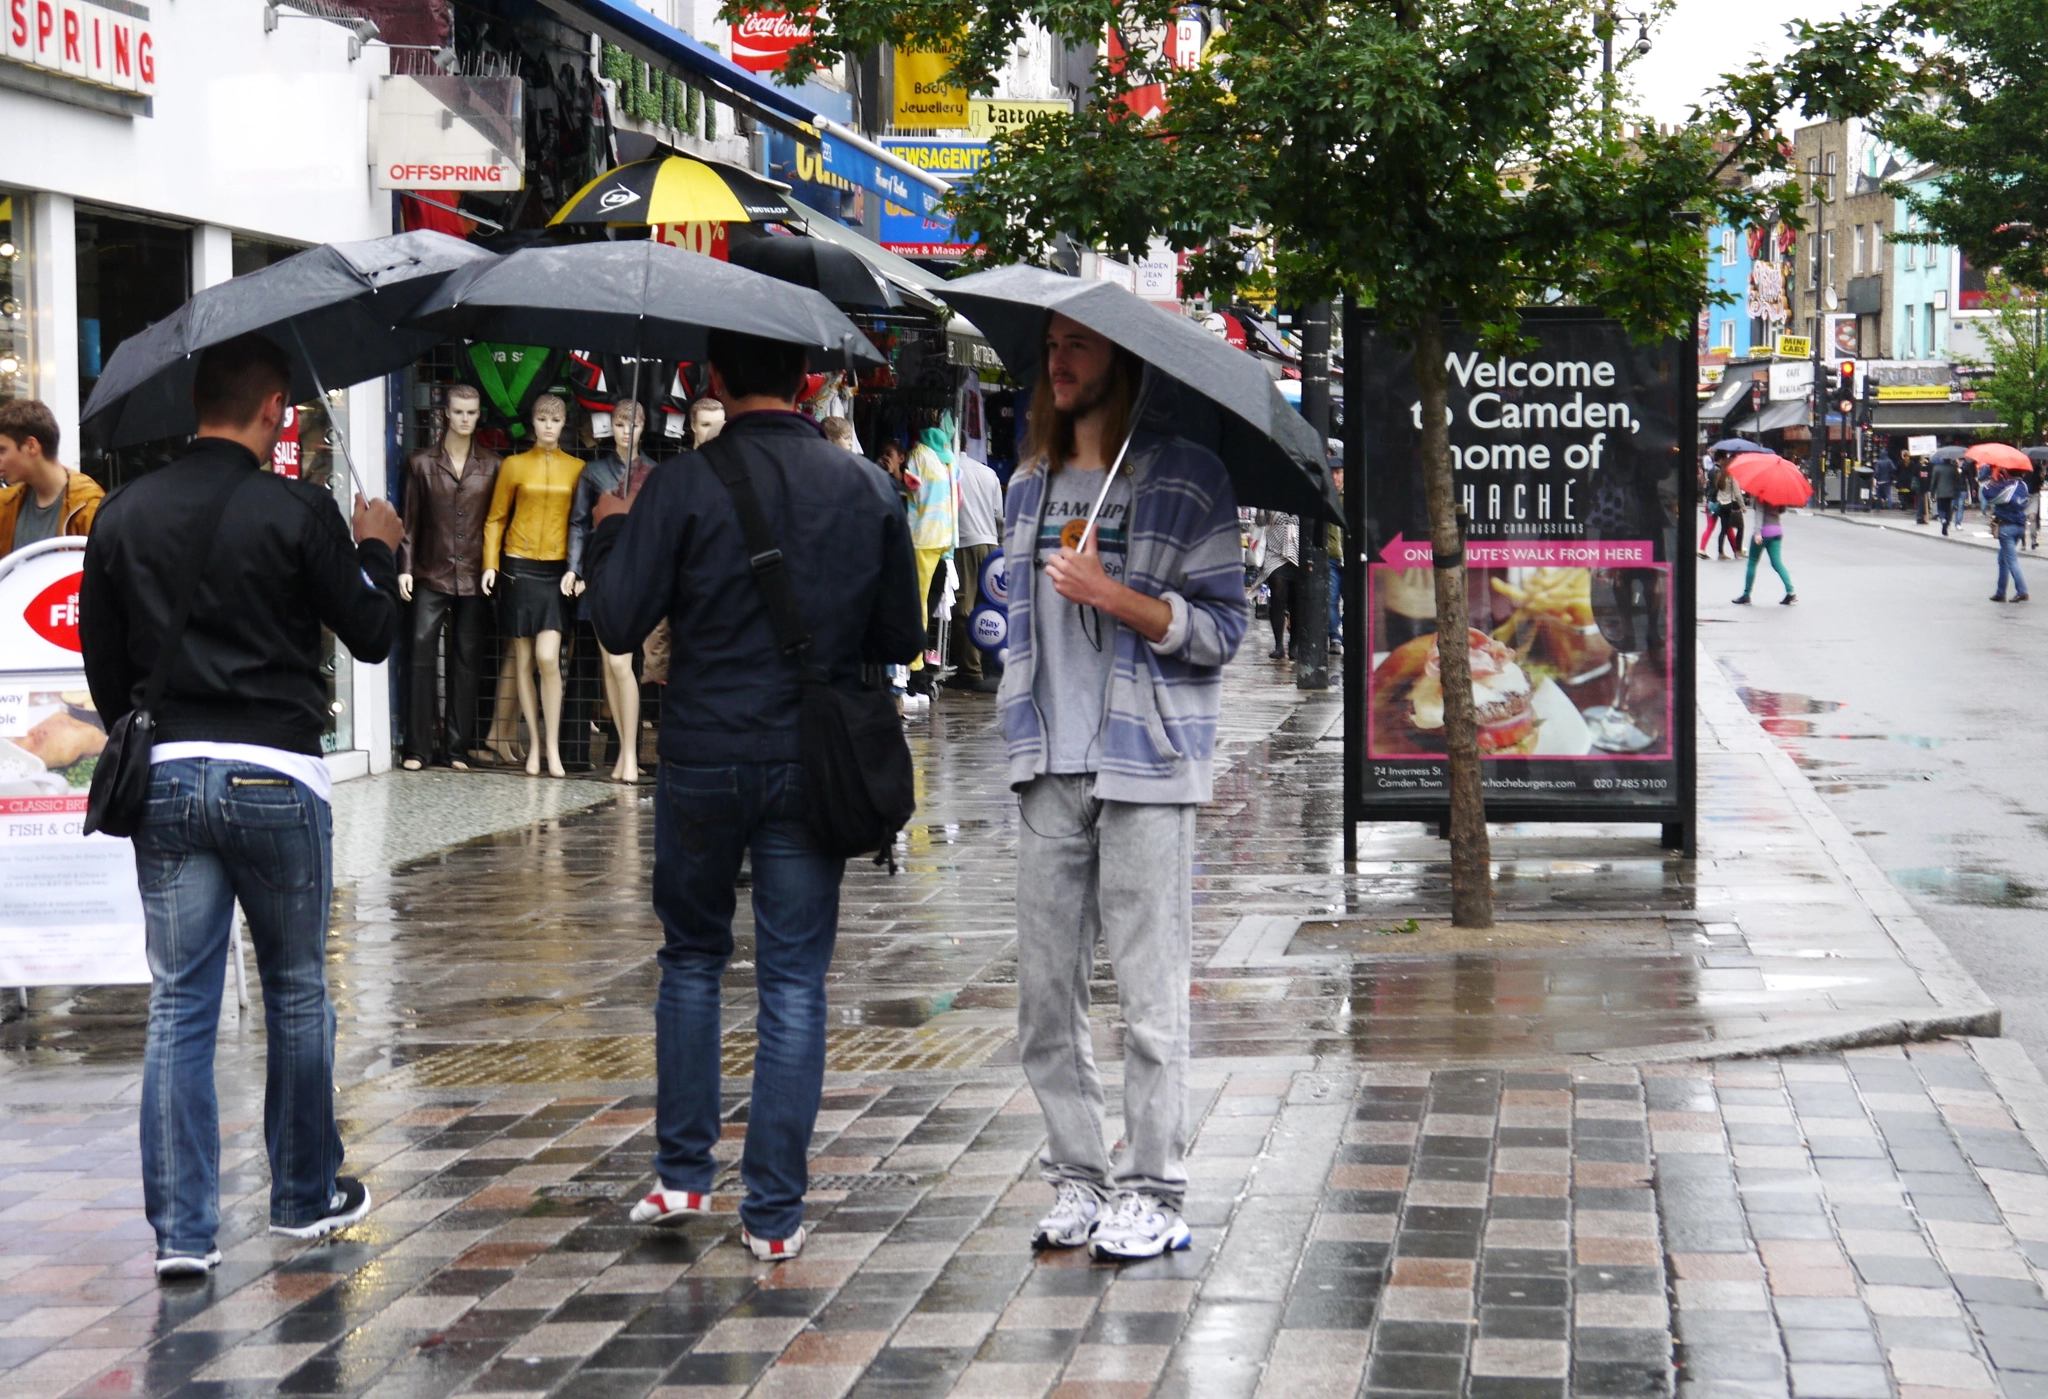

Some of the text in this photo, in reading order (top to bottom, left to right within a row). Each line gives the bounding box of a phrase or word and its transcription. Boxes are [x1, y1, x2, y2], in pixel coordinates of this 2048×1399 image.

[11, 0, 155, 84] SPRING
[914, 82, 948, 97] Body
[900, 103, 963, 116] Jewellery
[390, 164, 501, 182] OFFSPRING
[751, 206, 789, 214] DUNLOP
[891, 245, 986, 256] News & Magazes
[1784, 337, 1806, 346] MINI
[1468, 392, 1641, 434] Camden,
[274, 441, 297, 465] SALE
[1564, 432, 1606, 470] of
[1463, 478, 1576, 520] HACHÉ
[1512, 549, 1555, 561] WALK
[1560, 549, 1600, 561] FROM
[1605, 549, 1642, 561] HERE
[980, 618, 1000, 629] Play
[979, 627, 1000, 637] here
[1373, 766, 1444, 776] 24 Inverness St.
[1378, 778, 1443, 788] Camden Town
[1593, 779, 1613, 789] 020
[1615, 779, 1640, 789] 7485
[1642, 779, 1668, 789] 9100
[9, 800, 63, 813] CLASSIC
[9, 823, 43, 837] FISH
[48, 823, 59, 836] &
